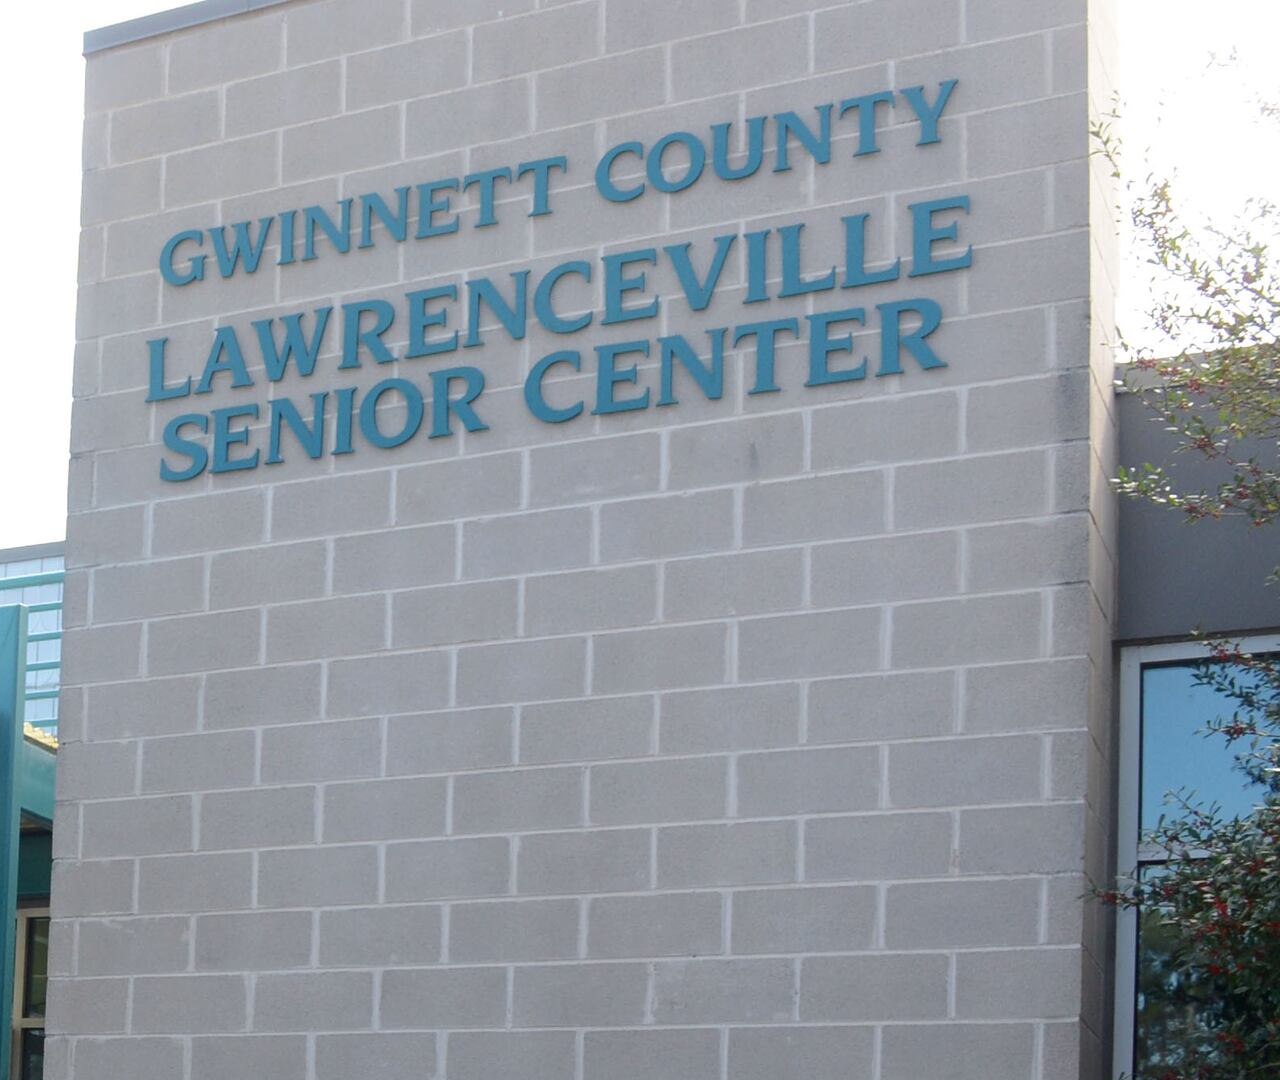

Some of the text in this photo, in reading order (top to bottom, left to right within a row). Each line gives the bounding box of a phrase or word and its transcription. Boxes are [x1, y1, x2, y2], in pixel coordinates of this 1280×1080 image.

[159, 78, 959, 288] GWINNETT COUNTY
[145, 194, 974, 403] LAWRENCEVILLE
[159, 297, 948, 482] SENIOR CENTER
